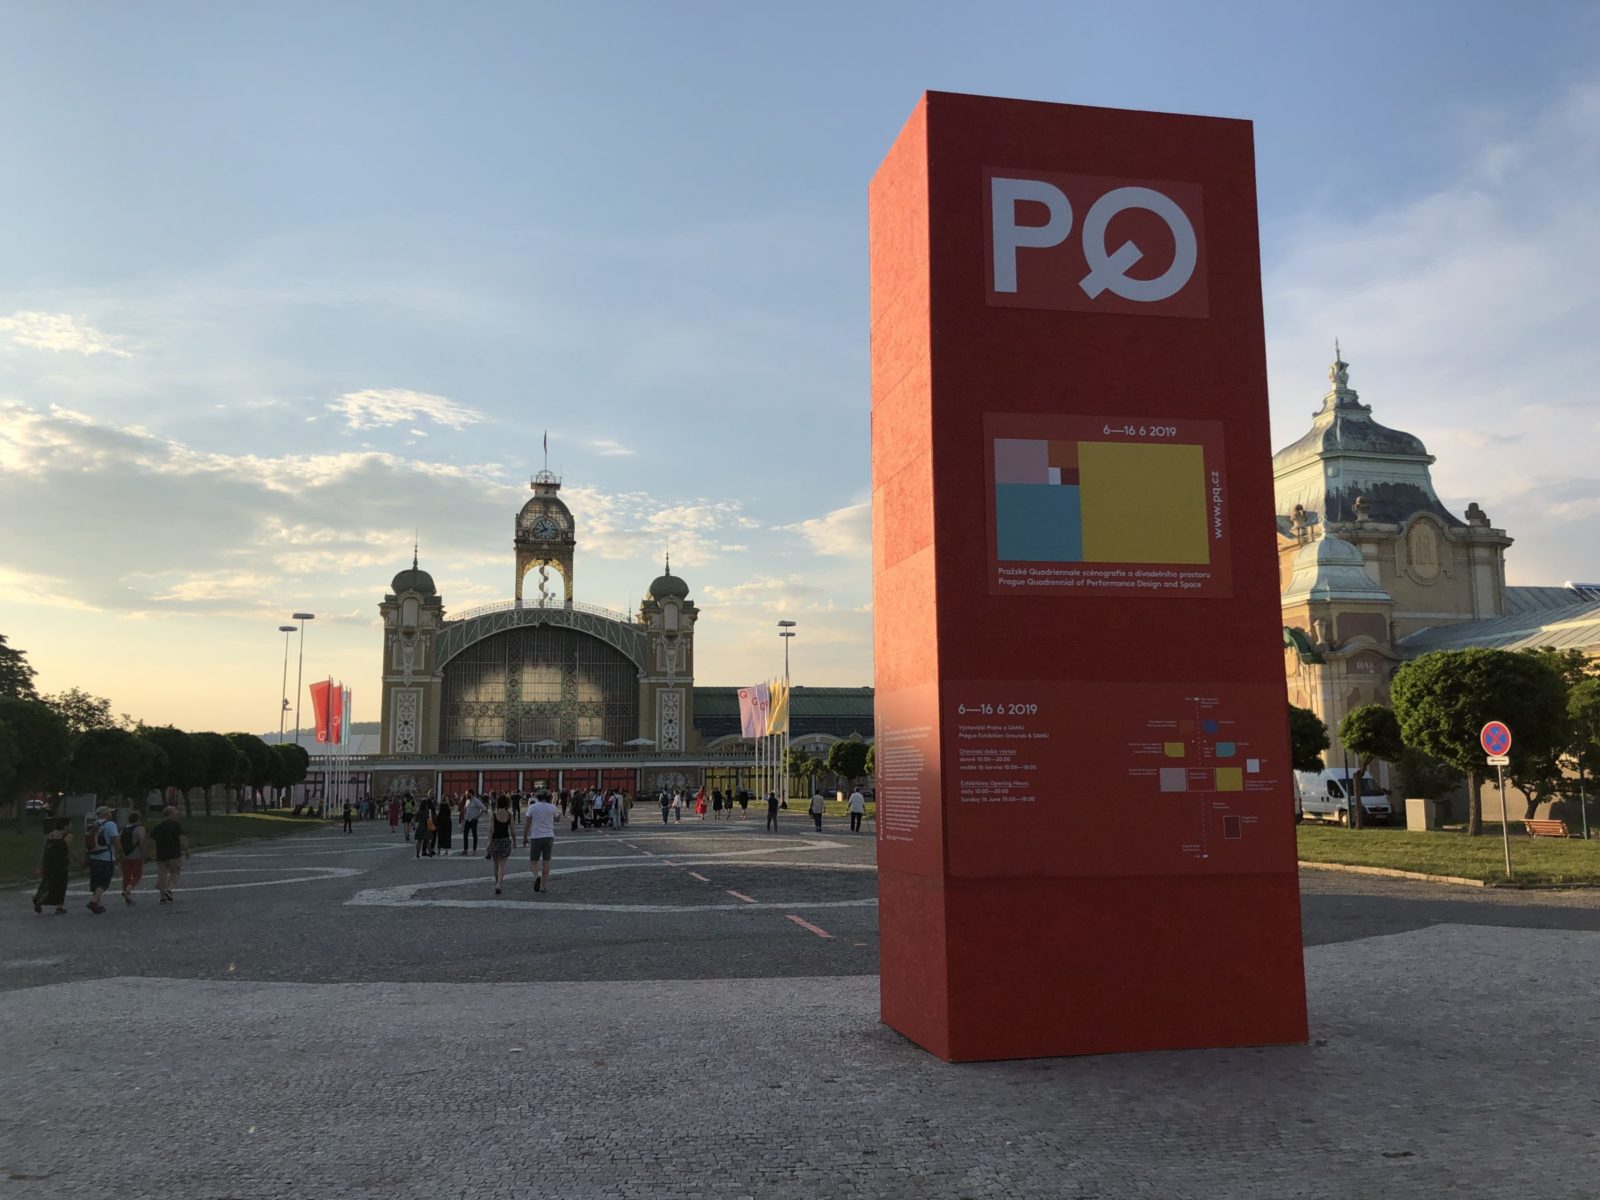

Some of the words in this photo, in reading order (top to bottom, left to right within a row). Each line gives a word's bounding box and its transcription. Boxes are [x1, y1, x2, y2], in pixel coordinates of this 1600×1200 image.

[991, 177, 1198, 302] PQ
[1139, 425, 1146, 436] 6
[1149, 426, 1177, 437] 2019
[1211, 471, 1223, 539] www.pq.cz
[1029, 567, 1081, 577] Quadriennale
[1082, 569, 1126, 579] scénografie
[1179, 571, 1211, 579] prostoru
[998, 577, 1026, 587] Prague
[1026, 577, 1074, 586] Quadrennial
[1076, 578, 1084, 586] of
[1086, 579, 1135, 587] Performance
[1137, 579, 1162, 589] Design
[1163, 580, 1178, 588] and
[1179, 580, 1202, 589] Space
[996, 703, 1005, 715] 6
[1008, 703, 1038, 715] 2019
